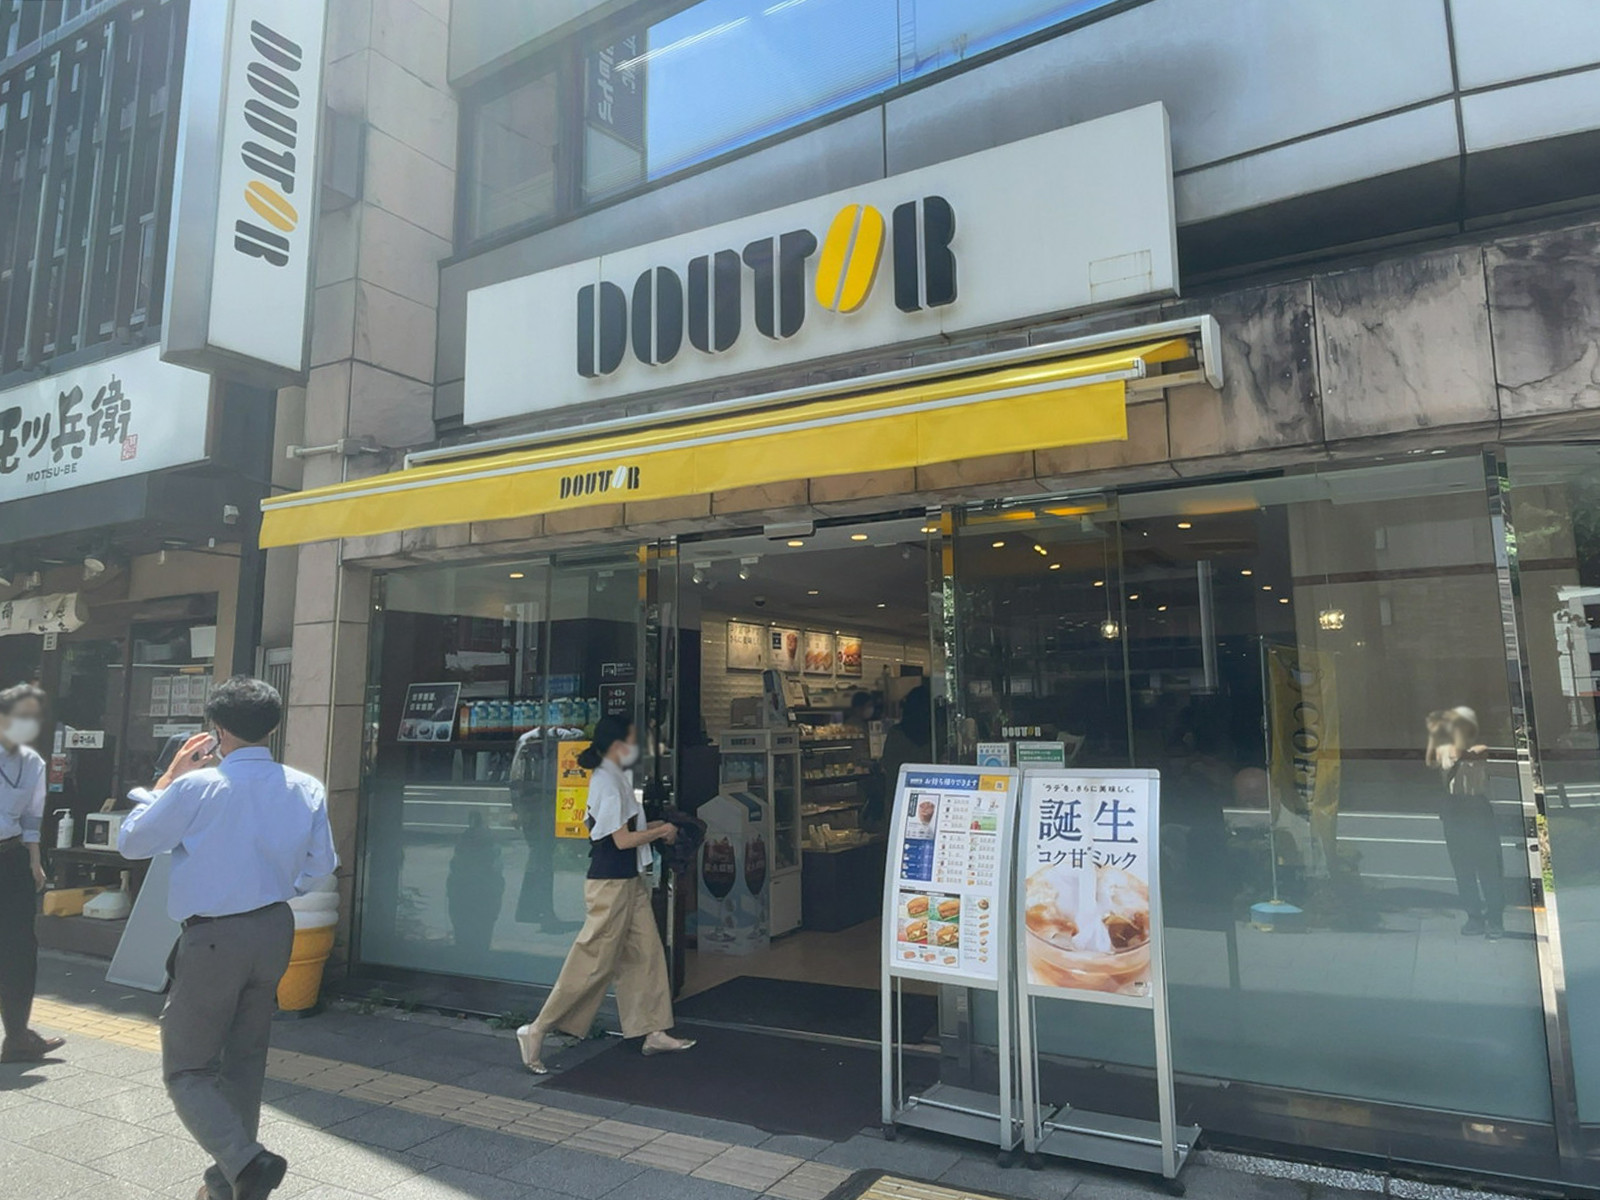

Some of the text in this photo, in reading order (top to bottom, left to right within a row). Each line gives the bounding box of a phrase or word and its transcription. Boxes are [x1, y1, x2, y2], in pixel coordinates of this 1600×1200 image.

[234, 20, 302, 267] DOUTOR
[576, 195, 958, 379] DOUTOR
[26, 463, 78, 483] MOTSU-BE
[560, 465, 640, 499] DOUTOR
[1039, 798, 1139, 843] 誕生
